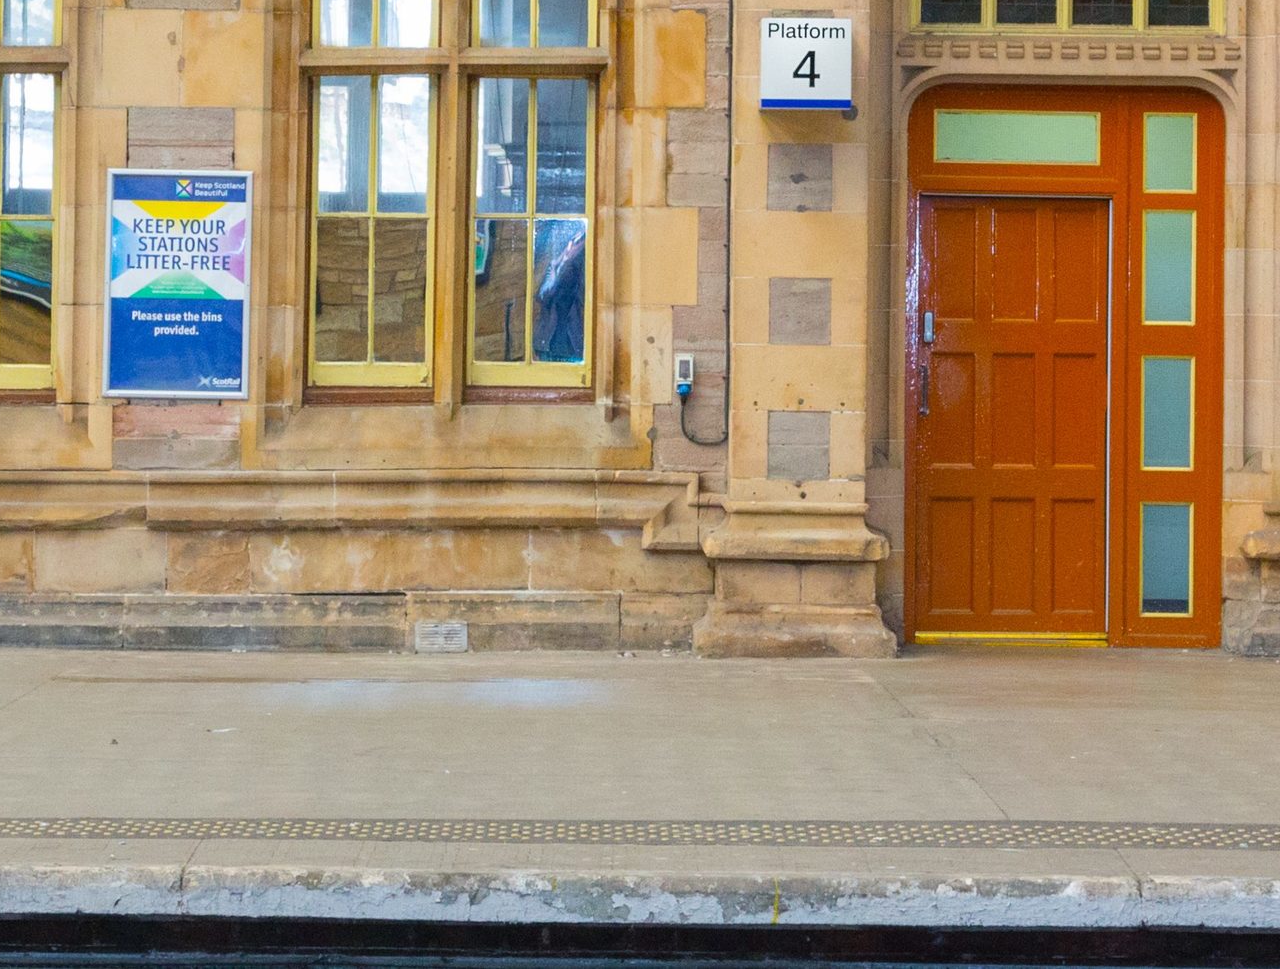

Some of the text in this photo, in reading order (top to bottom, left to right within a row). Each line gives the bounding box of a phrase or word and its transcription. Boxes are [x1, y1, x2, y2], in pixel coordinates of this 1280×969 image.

[768, 23, 845, 39] Platform
[792, 50, 820, 87] 4
[195, 189, 228, 197] Beautiful
[214, 182, 245, 190] Scotland
[133, 219, 225, 235] KEEP YOUR
[139, 237, 218, 252] STATIONS
[127, 254, 231, 271] LITTER-FREE
[132, 310, 222, 322] Please use the bins
[154, 326, 199, 336] provided.
